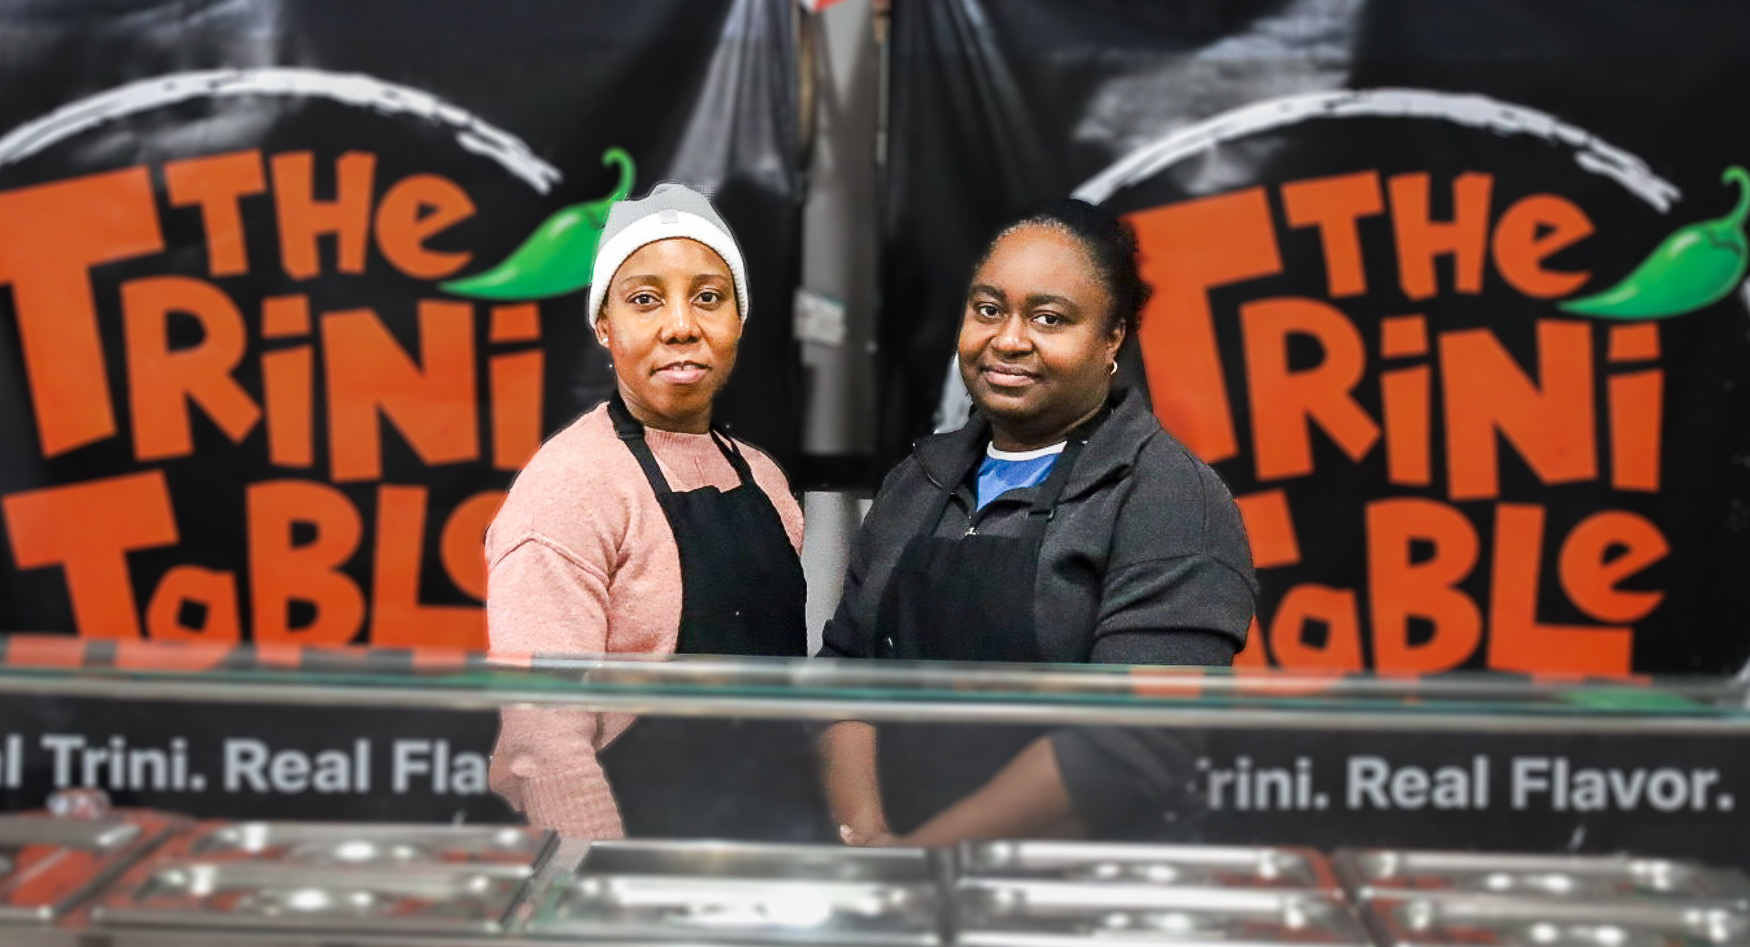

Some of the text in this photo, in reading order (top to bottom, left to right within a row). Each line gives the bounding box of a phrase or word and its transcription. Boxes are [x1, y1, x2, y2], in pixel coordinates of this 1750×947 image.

[42, 735, 206, 790] Trini.
[224, 739, 371, 793] Real
[392, 739, 488, 794] Fla
[1197, 756, 1733, 811] rini. Real Flavor.
